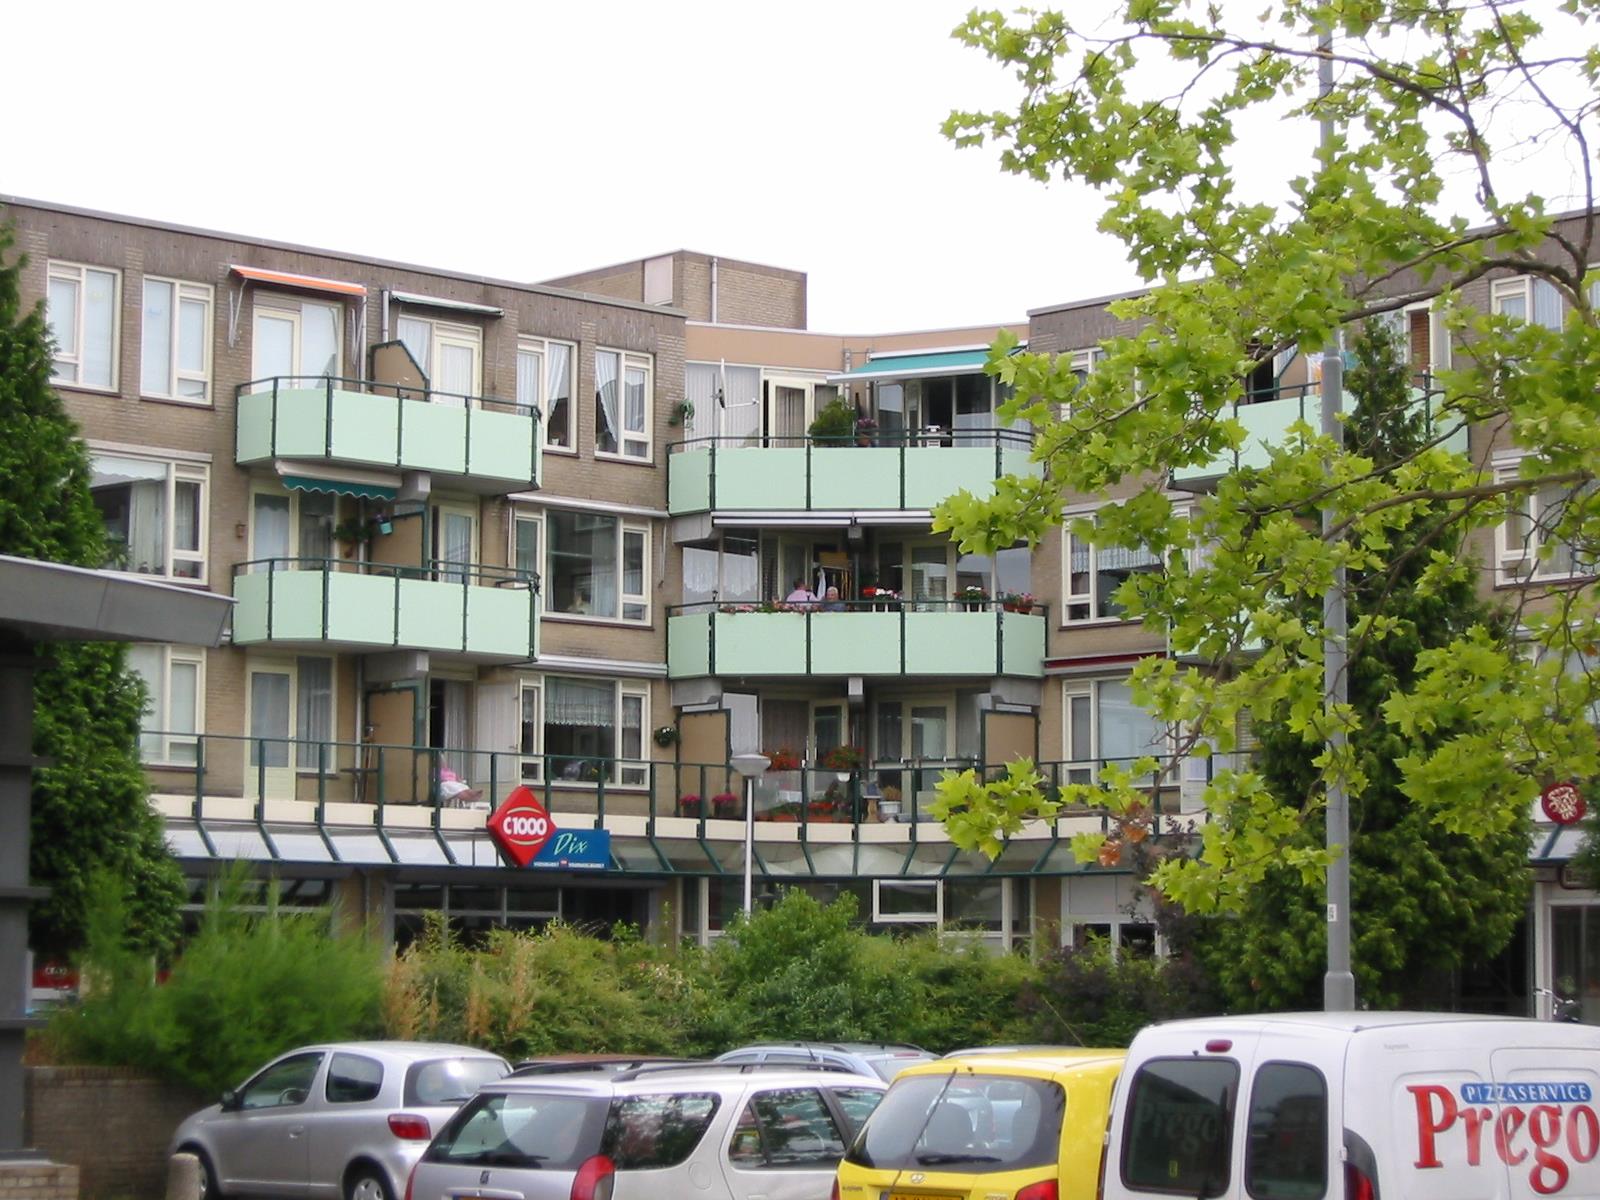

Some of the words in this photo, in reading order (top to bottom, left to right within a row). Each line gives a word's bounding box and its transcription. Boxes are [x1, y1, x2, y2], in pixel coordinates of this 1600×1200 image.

[504, 818, 548, 835] C1000
[554, 833, 587, 855] Dix
[1466, 1085, 1588, 1102] PIZZASERVICE
[1407, 1086, 1600, 1194] Prego
